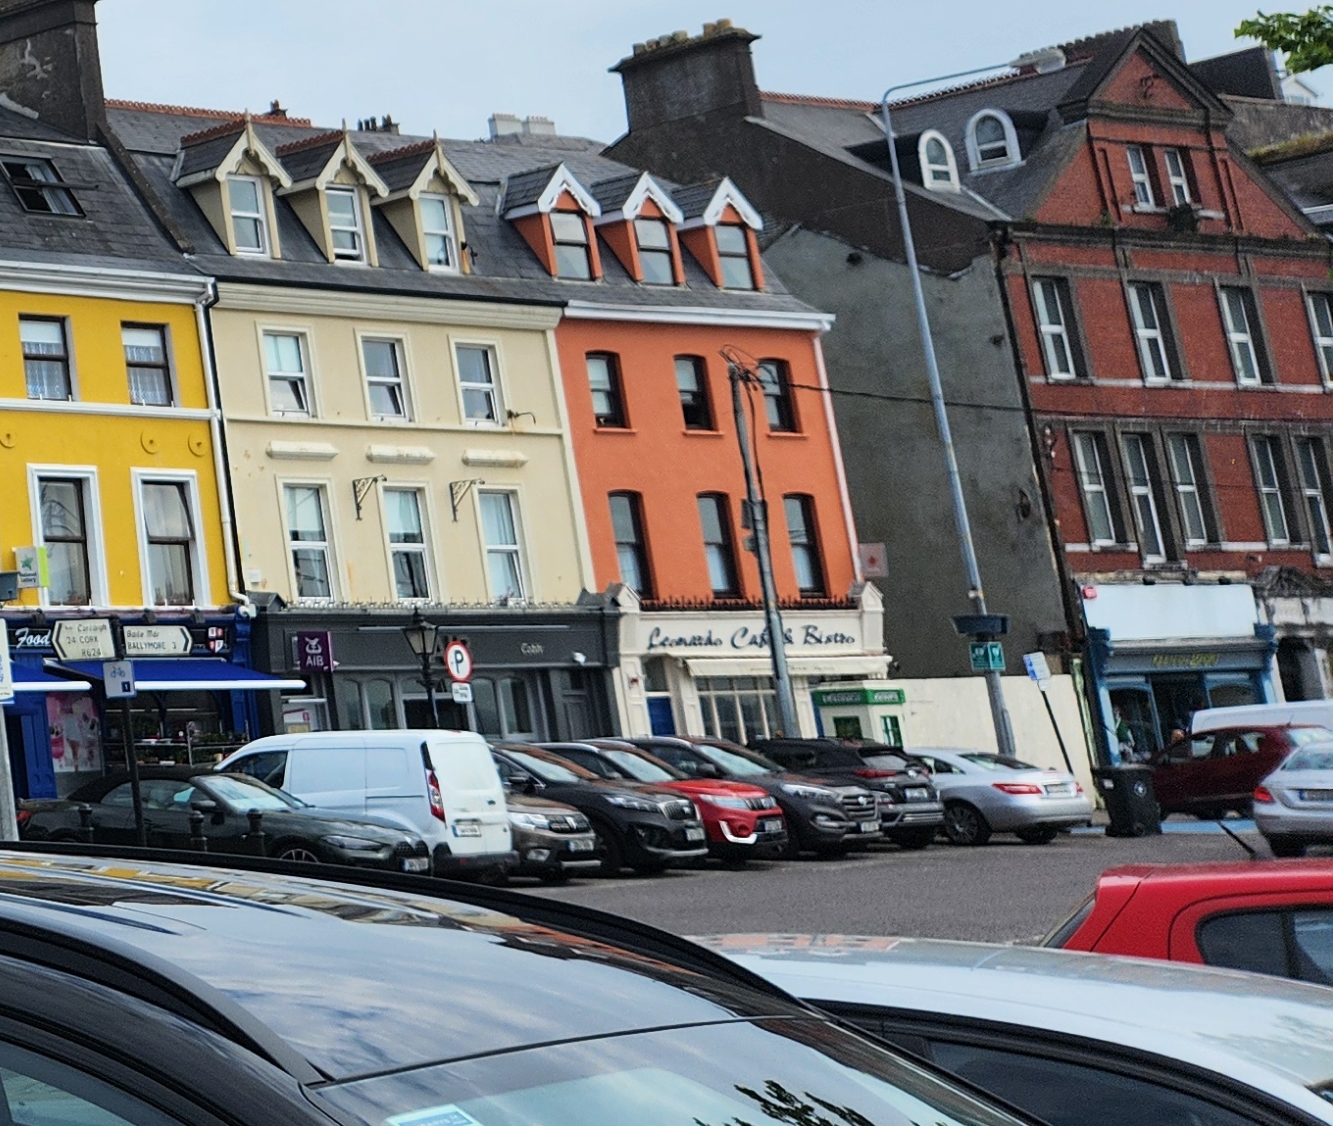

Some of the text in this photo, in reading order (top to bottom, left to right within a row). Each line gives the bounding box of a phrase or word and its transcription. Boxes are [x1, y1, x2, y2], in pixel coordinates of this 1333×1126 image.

[15, 627, 52, 649] Food
[79, 635, 99, 644] CORK
[730, 626, 770, 650] Caf
[801, 624, 856, 645] Bistro
[127, 641, 166, 650] BALLYMORE
[82, 648, 102, 657] R624
[306, 655, 324, 667] AIB
[454, 649, 464, 673] P
